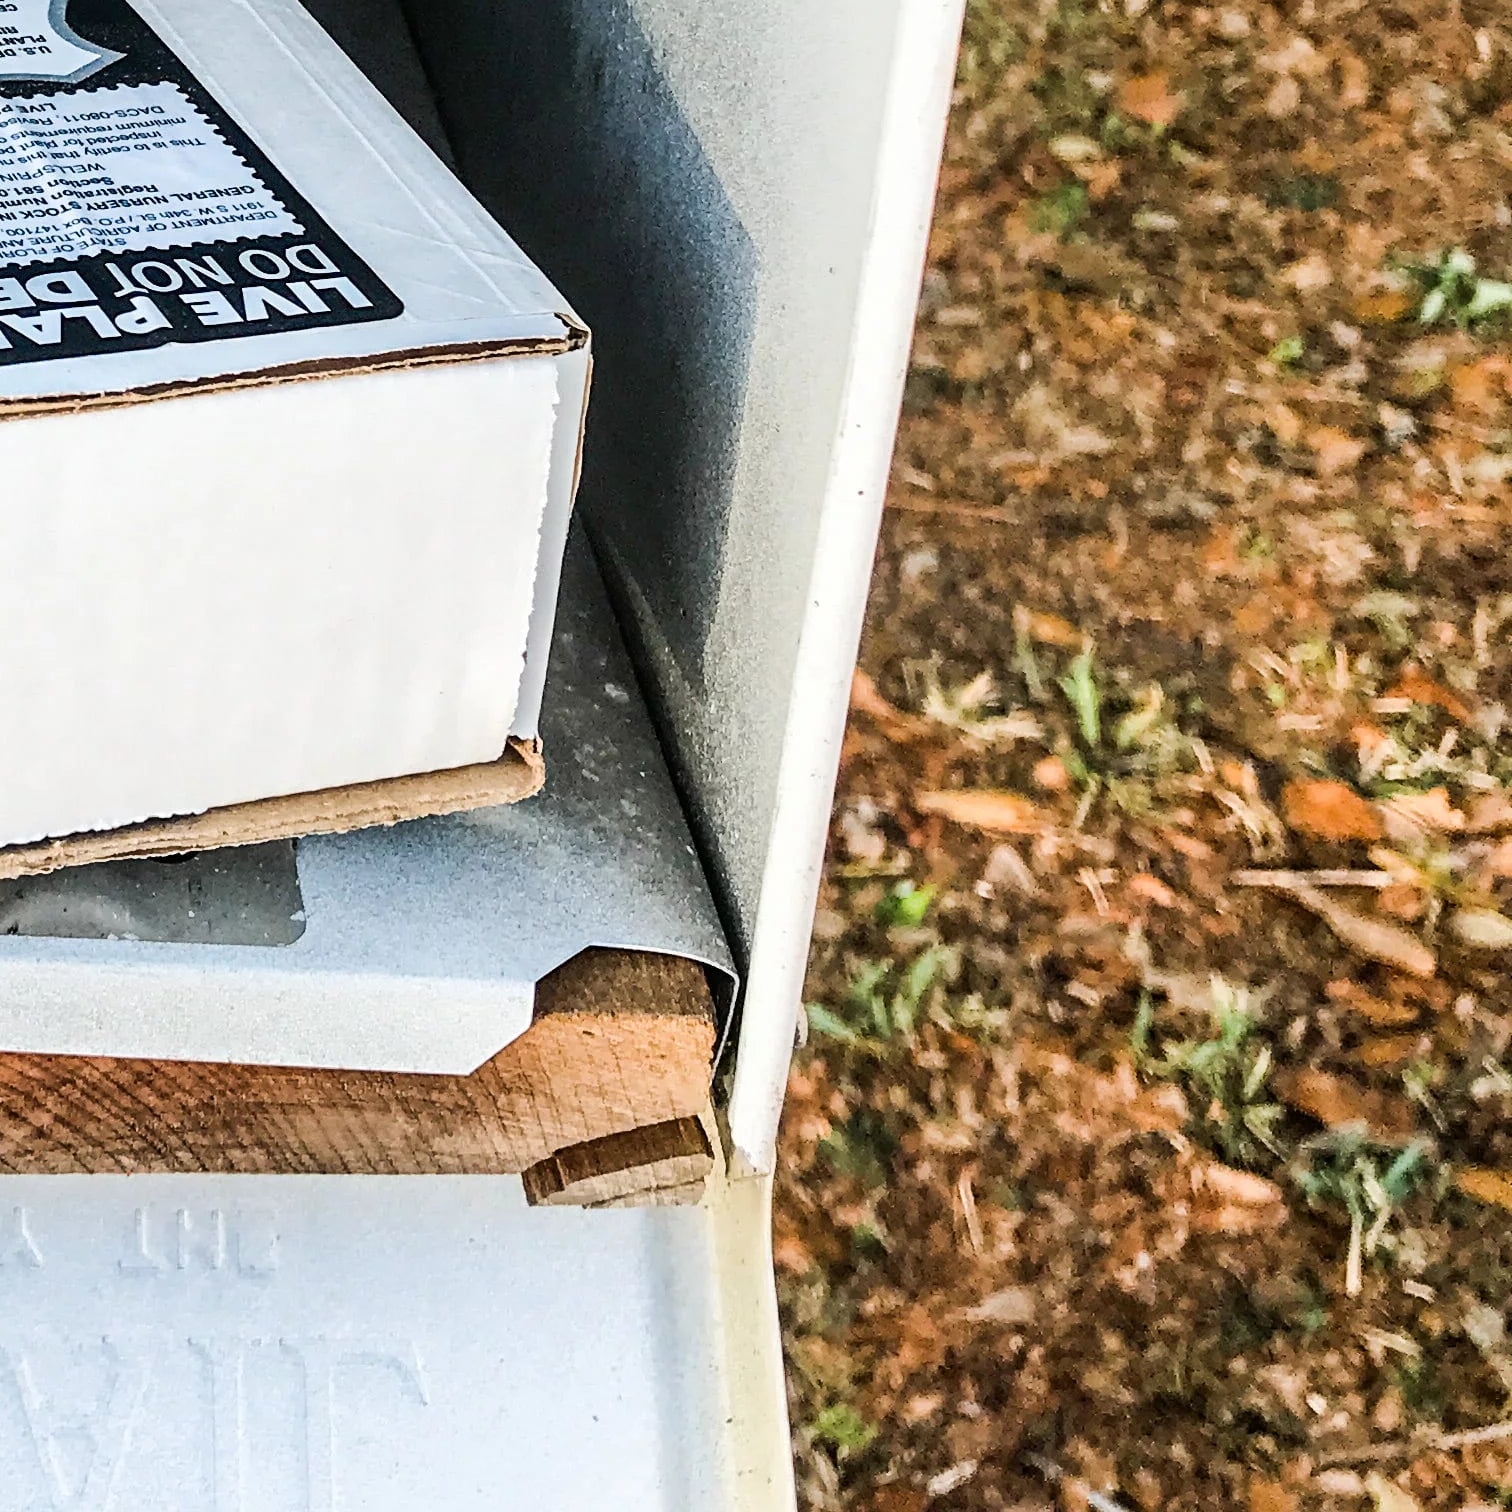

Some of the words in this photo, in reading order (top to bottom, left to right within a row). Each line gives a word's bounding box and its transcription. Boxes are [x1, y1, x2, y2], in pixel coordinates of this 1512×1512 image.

[18, 45, 52, 55] U.S.
[15, 101, 56, 114] LIVE
[115, 115, 187, 130] minimum
[62, 136, 84, 149] for
[86, 129, 162, 146] inspected
[170, 136, 206, 149] This
[134, 143, 151, 153] to
[153, 141, 167, 151] is
[50, 148, 81, 162] that
[47, 176, 114, 190] Section
[51, 183, 159, 201] Registration
[170, 184, 255, 201] GENERAL
[85, 194, 169, 211] NURSERY
[232, 200, 264, 212] 1911
[21, 200, 81, 220] STOCK
[159, 209, 189, 221] 34th
[145, 222, 167, 232] OF
[171, 211, 277, 230] DEPARTMENT
[34, 225, 140, 246] AGRICULTURE
[52, 244, 71, 254] OF
[76, 238, 126, 251] STATE
[239, 244, 340, 279] DO
[105, 256, 234, 297] NOT
[179, 277, 373, 325] LIVE
